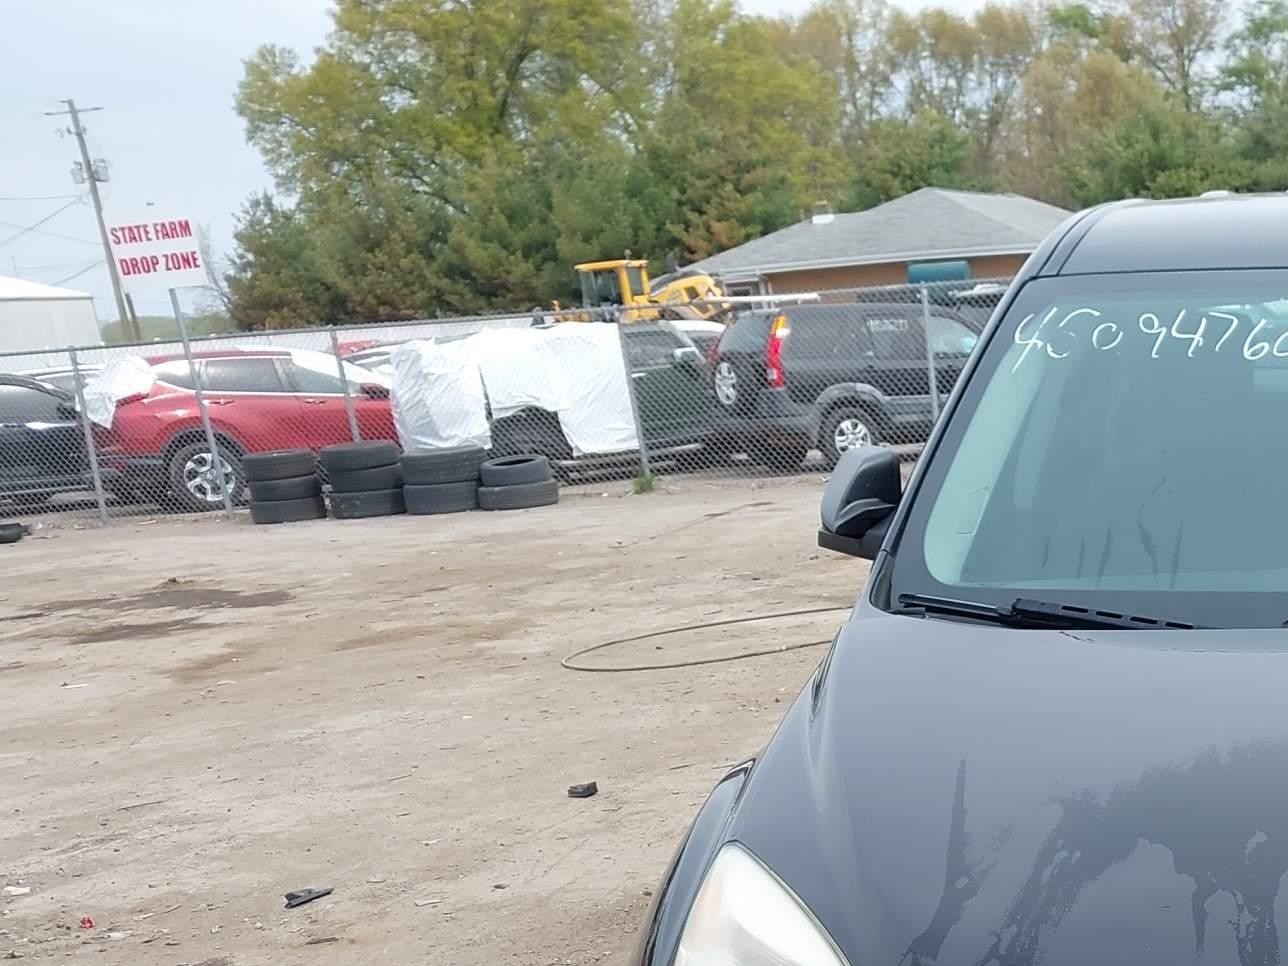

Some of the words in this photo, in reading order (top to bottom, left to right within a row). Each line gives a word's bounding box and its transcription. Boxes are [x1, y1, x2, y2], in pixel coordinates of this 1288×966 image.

[110, 223, 152, 245] STATE
[153, 219, 192, 240] FARM
[118, 255, 160, 276] DROP
[162, 251, 200, 271] ZONE
